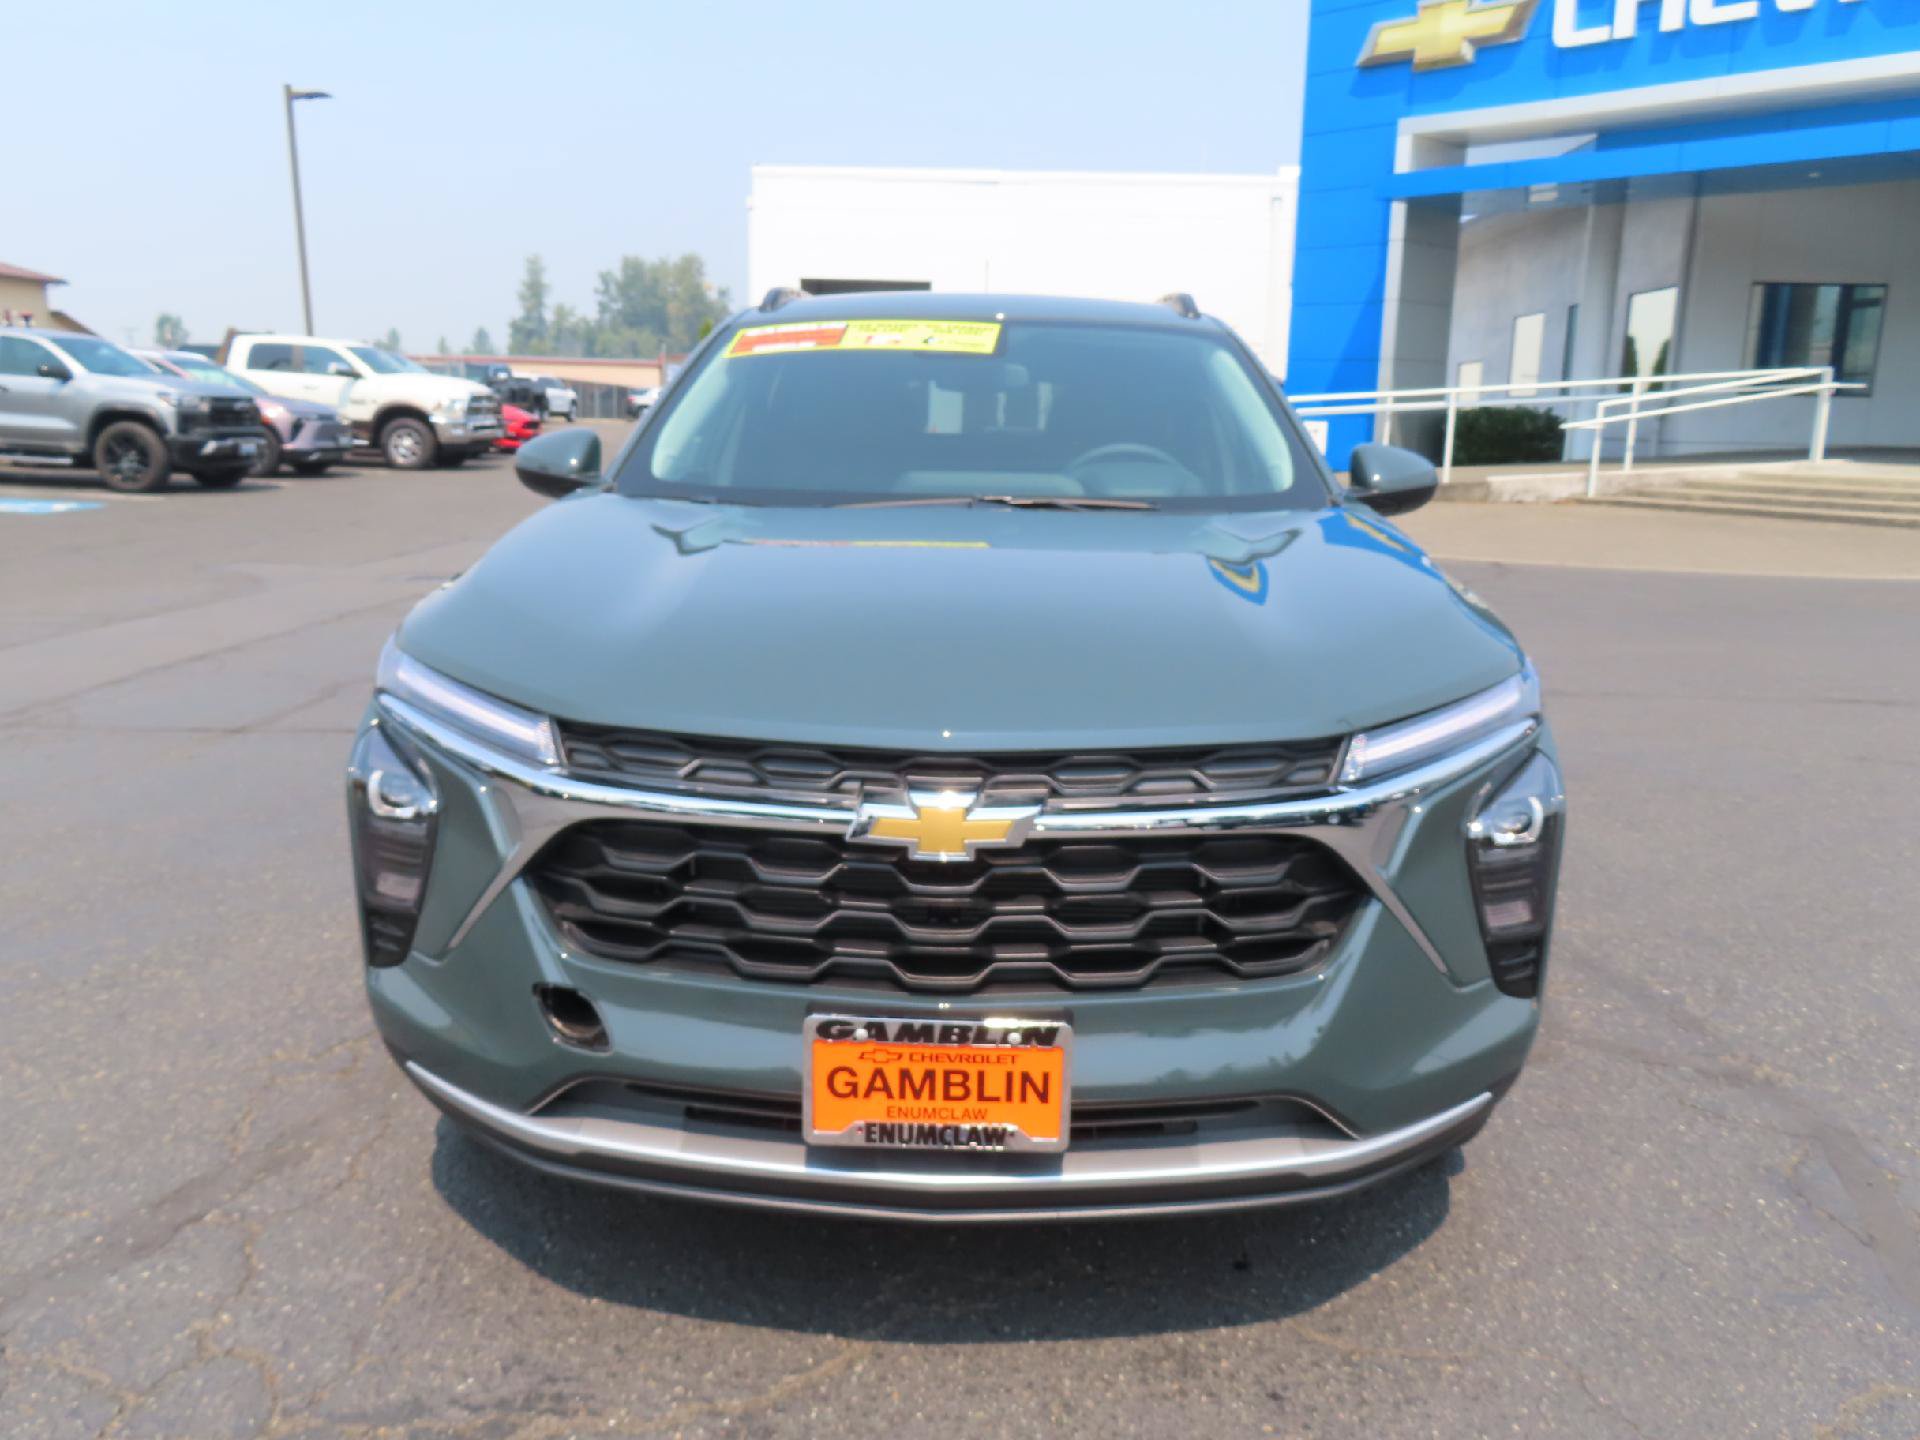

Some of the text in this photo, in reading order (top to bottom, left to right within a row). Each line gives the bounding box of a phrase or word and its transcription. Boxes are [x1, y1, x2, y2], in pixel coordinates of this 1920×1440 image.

[816, 1020, 1059, 1046] GAMBLIN
[909, 1052, 1019, 1065] CHEVROLET
[826, 1066, 1051, 1104] GAMBLIN
[886, 1106, 988, 1120] ENUMCLAW
[864, 1122, 1010, 1146] ENUMCLAW
